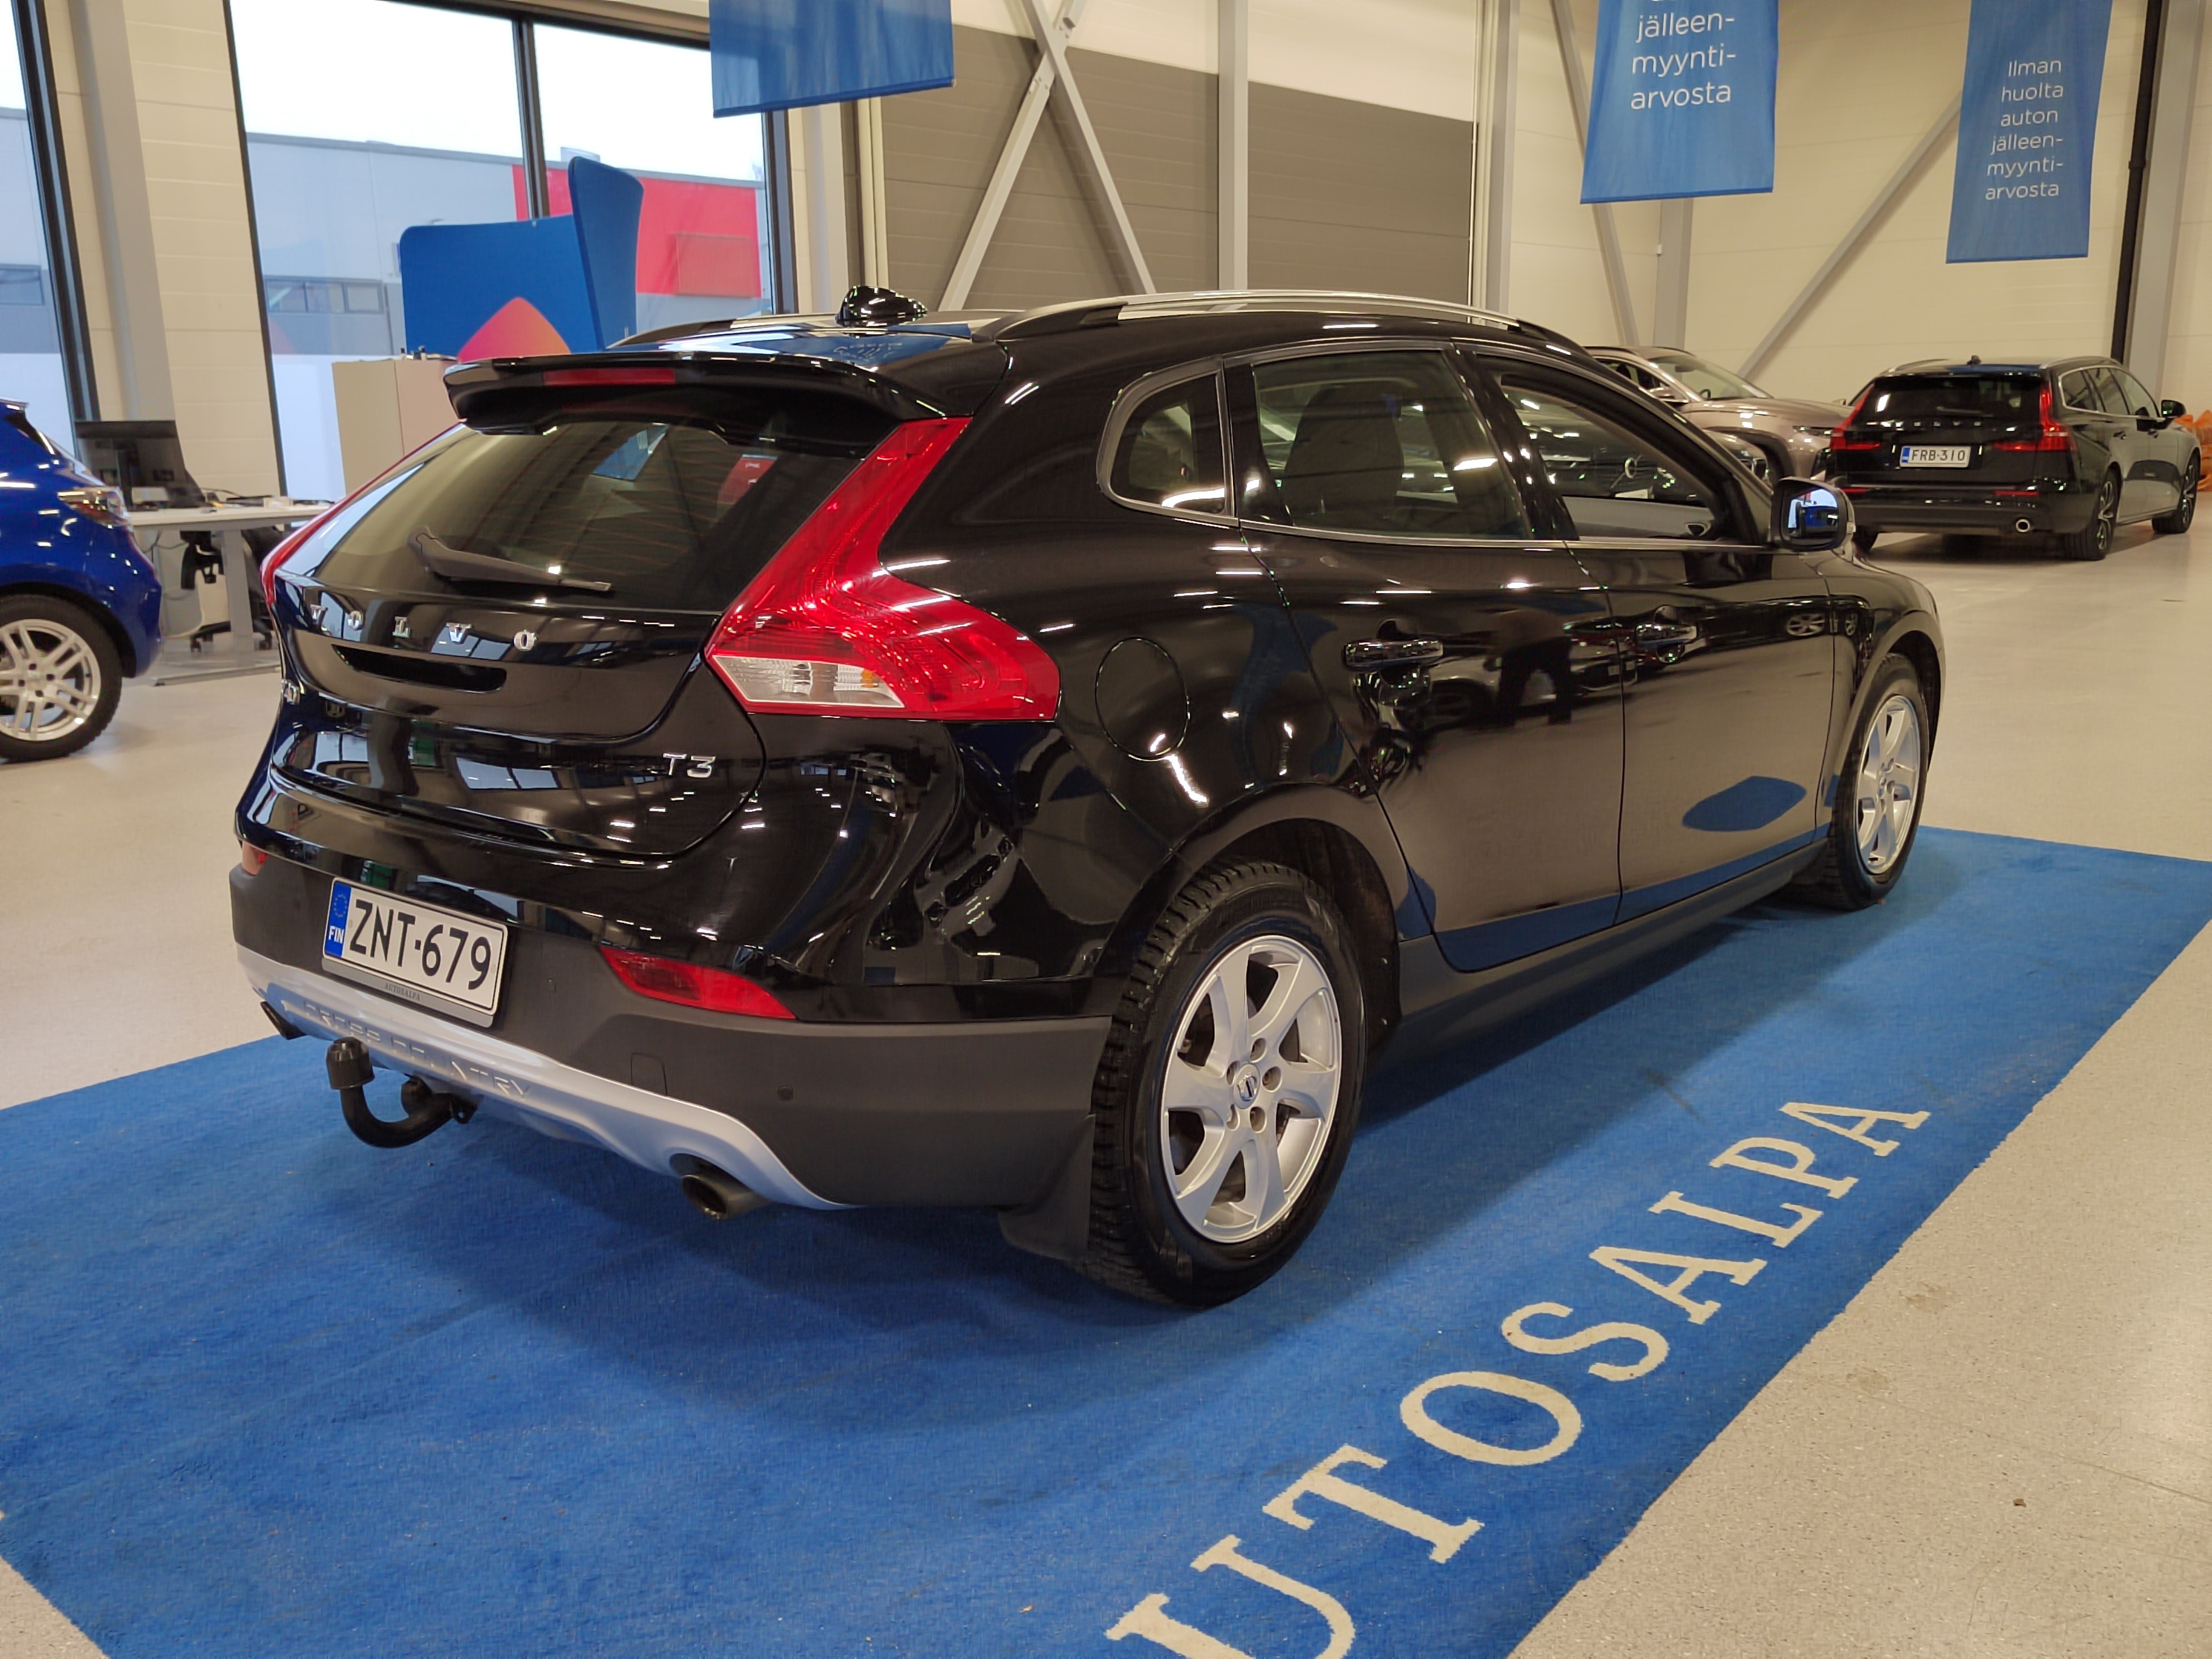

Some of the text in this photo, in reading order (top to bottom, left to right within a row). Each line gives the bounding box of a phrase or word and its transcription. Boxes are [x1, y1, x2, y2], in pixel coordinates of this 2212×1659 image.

[1635, 12, 1735, 44] jälleen-
[1632, 42, 1737, 78] myynti-
[2008, 59, 2062, 77] Ilman
[1631, 81, 1732, 110] arvosta
[2001, 82, 2064, 103] huolta
[2000, 109, 2058, 127] auton
[1990, 134, 2064, 156] jälleen-
[1986, 156, 2064, 178] myynti-
[1985, 181, 2060, 200] arvosta
[1911, 449, 1966, 461] FRB-310
[310, 603, 538, 652] VOLVO
[662, 752, 716, 778] T3
[328, 925, 344, 944] FIN
[349, 898, 491, 990] ZNT-679
